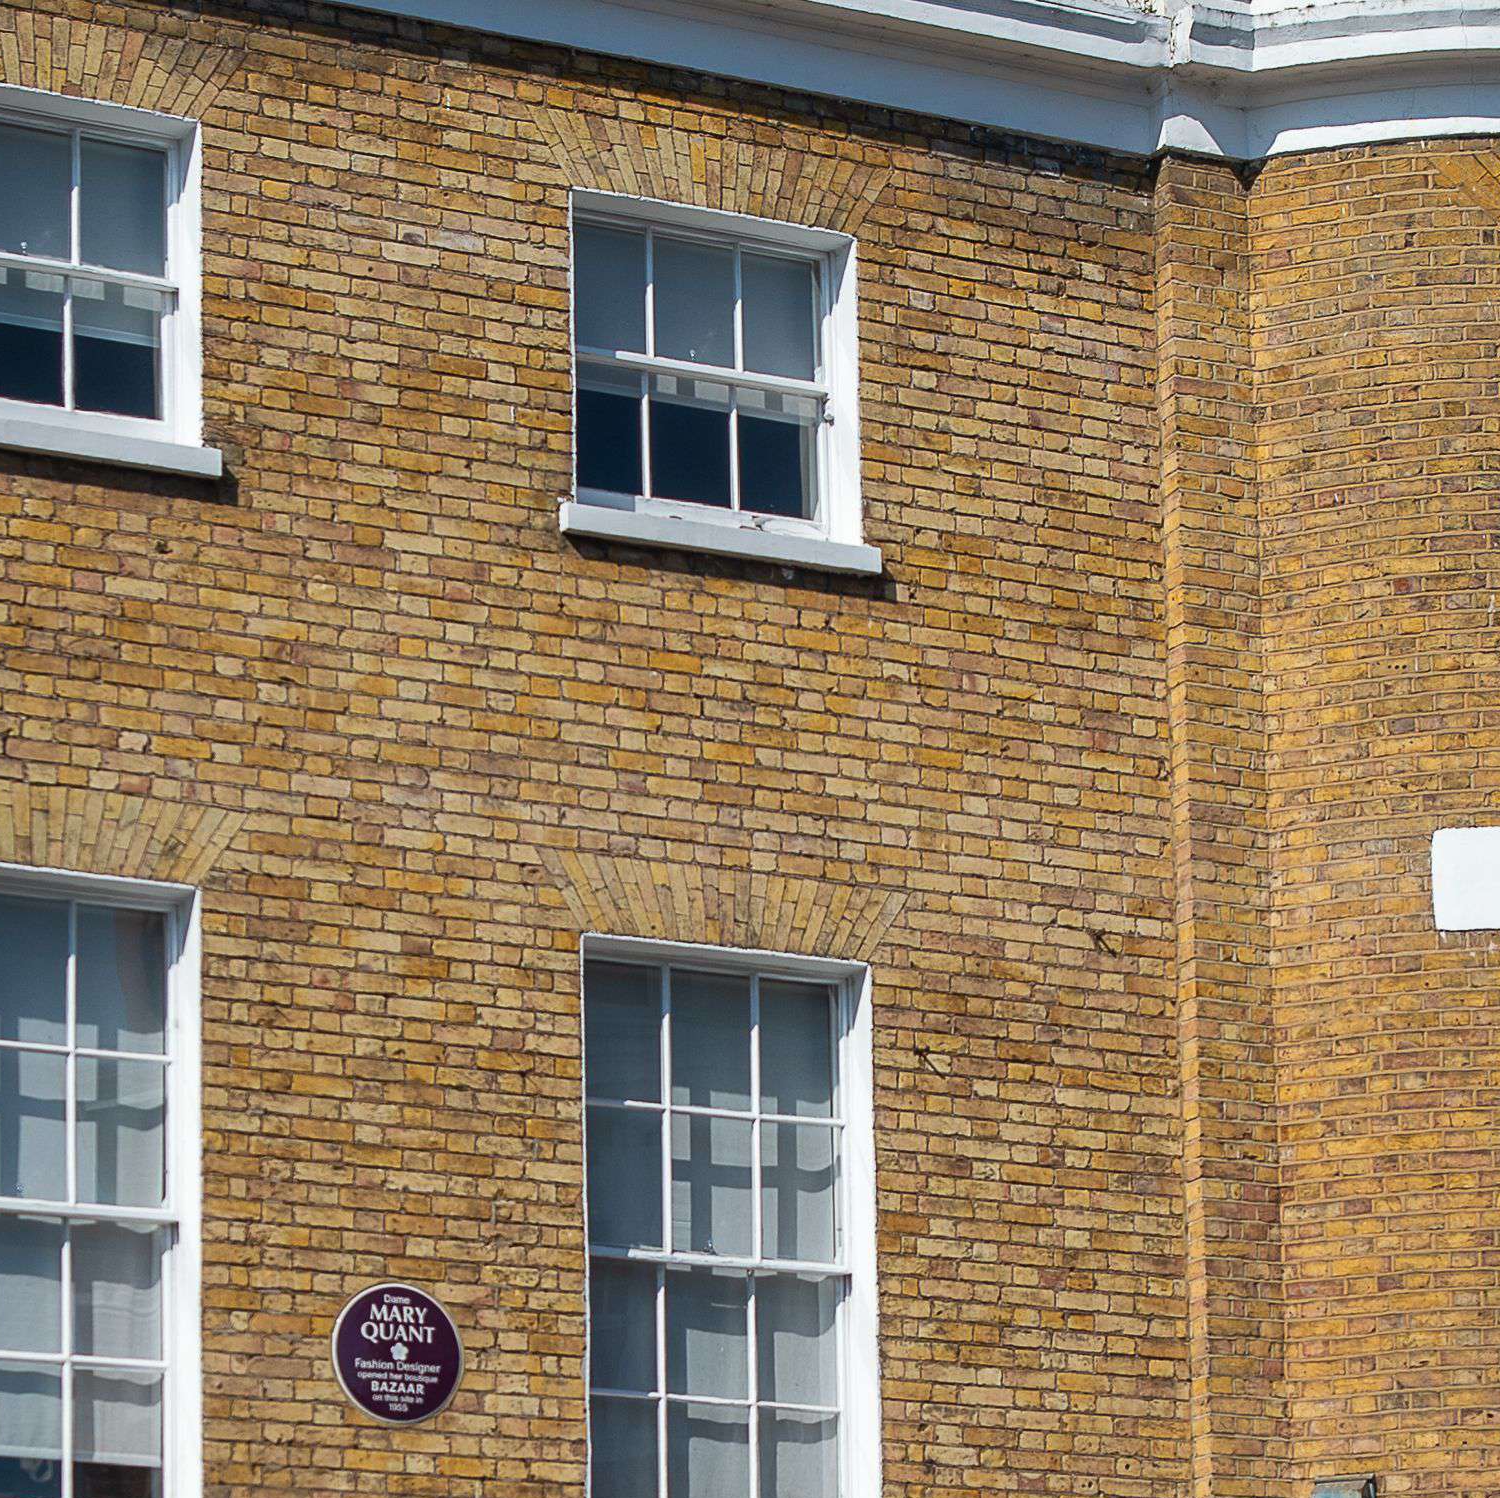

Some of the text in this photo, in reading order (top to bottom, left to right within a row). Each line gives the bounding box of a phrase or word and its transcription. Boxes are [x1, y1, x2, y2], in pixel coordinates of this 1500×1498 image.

[383, 1293, 410, 1304] Dame
[369, 1303, 427, 1324] MARY
[360, 1321, 436, 1343] QUANT
[354, 1357, 441, 1374] Fashion Designer
[357, 1371, 388, 1380] opened
[389, 1372, 403, 1381] her
[371, 1381, 425, 1395] BAZAAR
